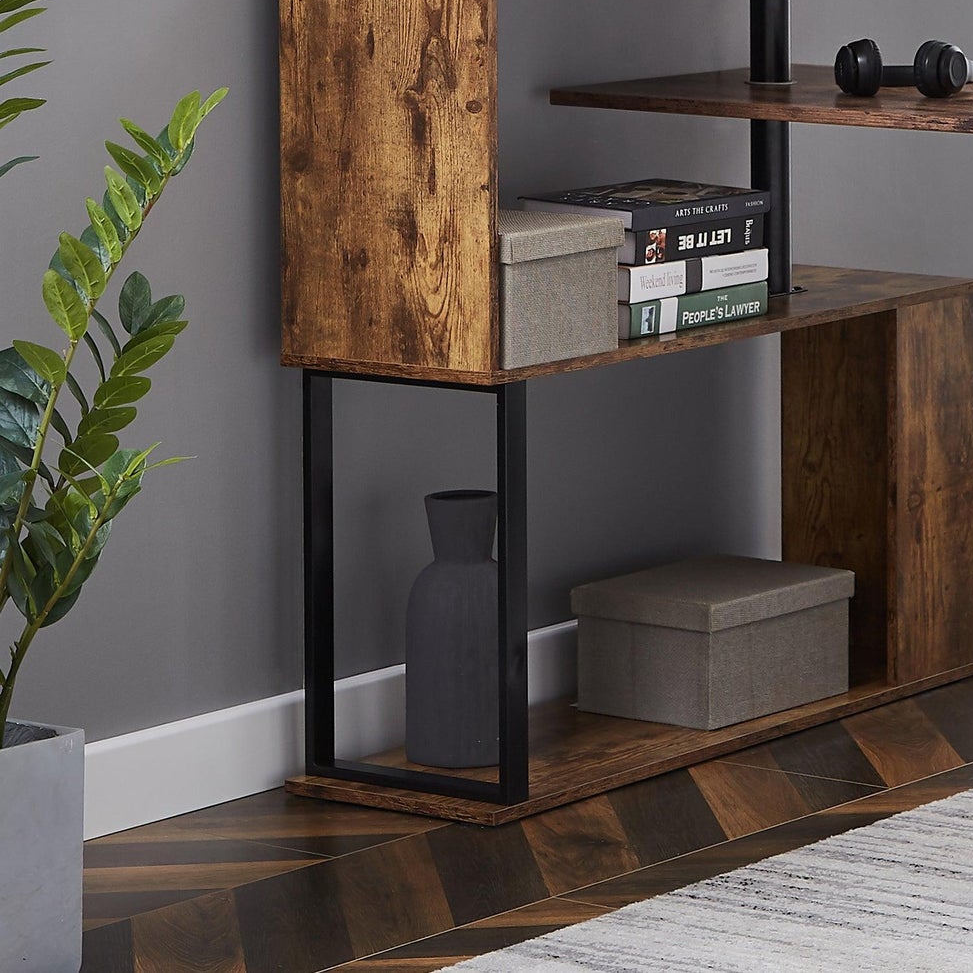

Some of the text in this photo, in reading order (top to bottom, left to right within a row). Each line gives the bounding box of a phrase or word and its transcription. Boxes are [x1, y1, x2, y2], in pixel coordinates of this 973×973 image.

[675, 203, 729, 218] ARTS THE CRAFTS
[678, 228, 732, 251] LET IT BE
[640, 270, 684, 290] Weekend living
[717, 294, 728, 302] THE
[682, 301, 761, 326] PEOPLE'S LAWYER
